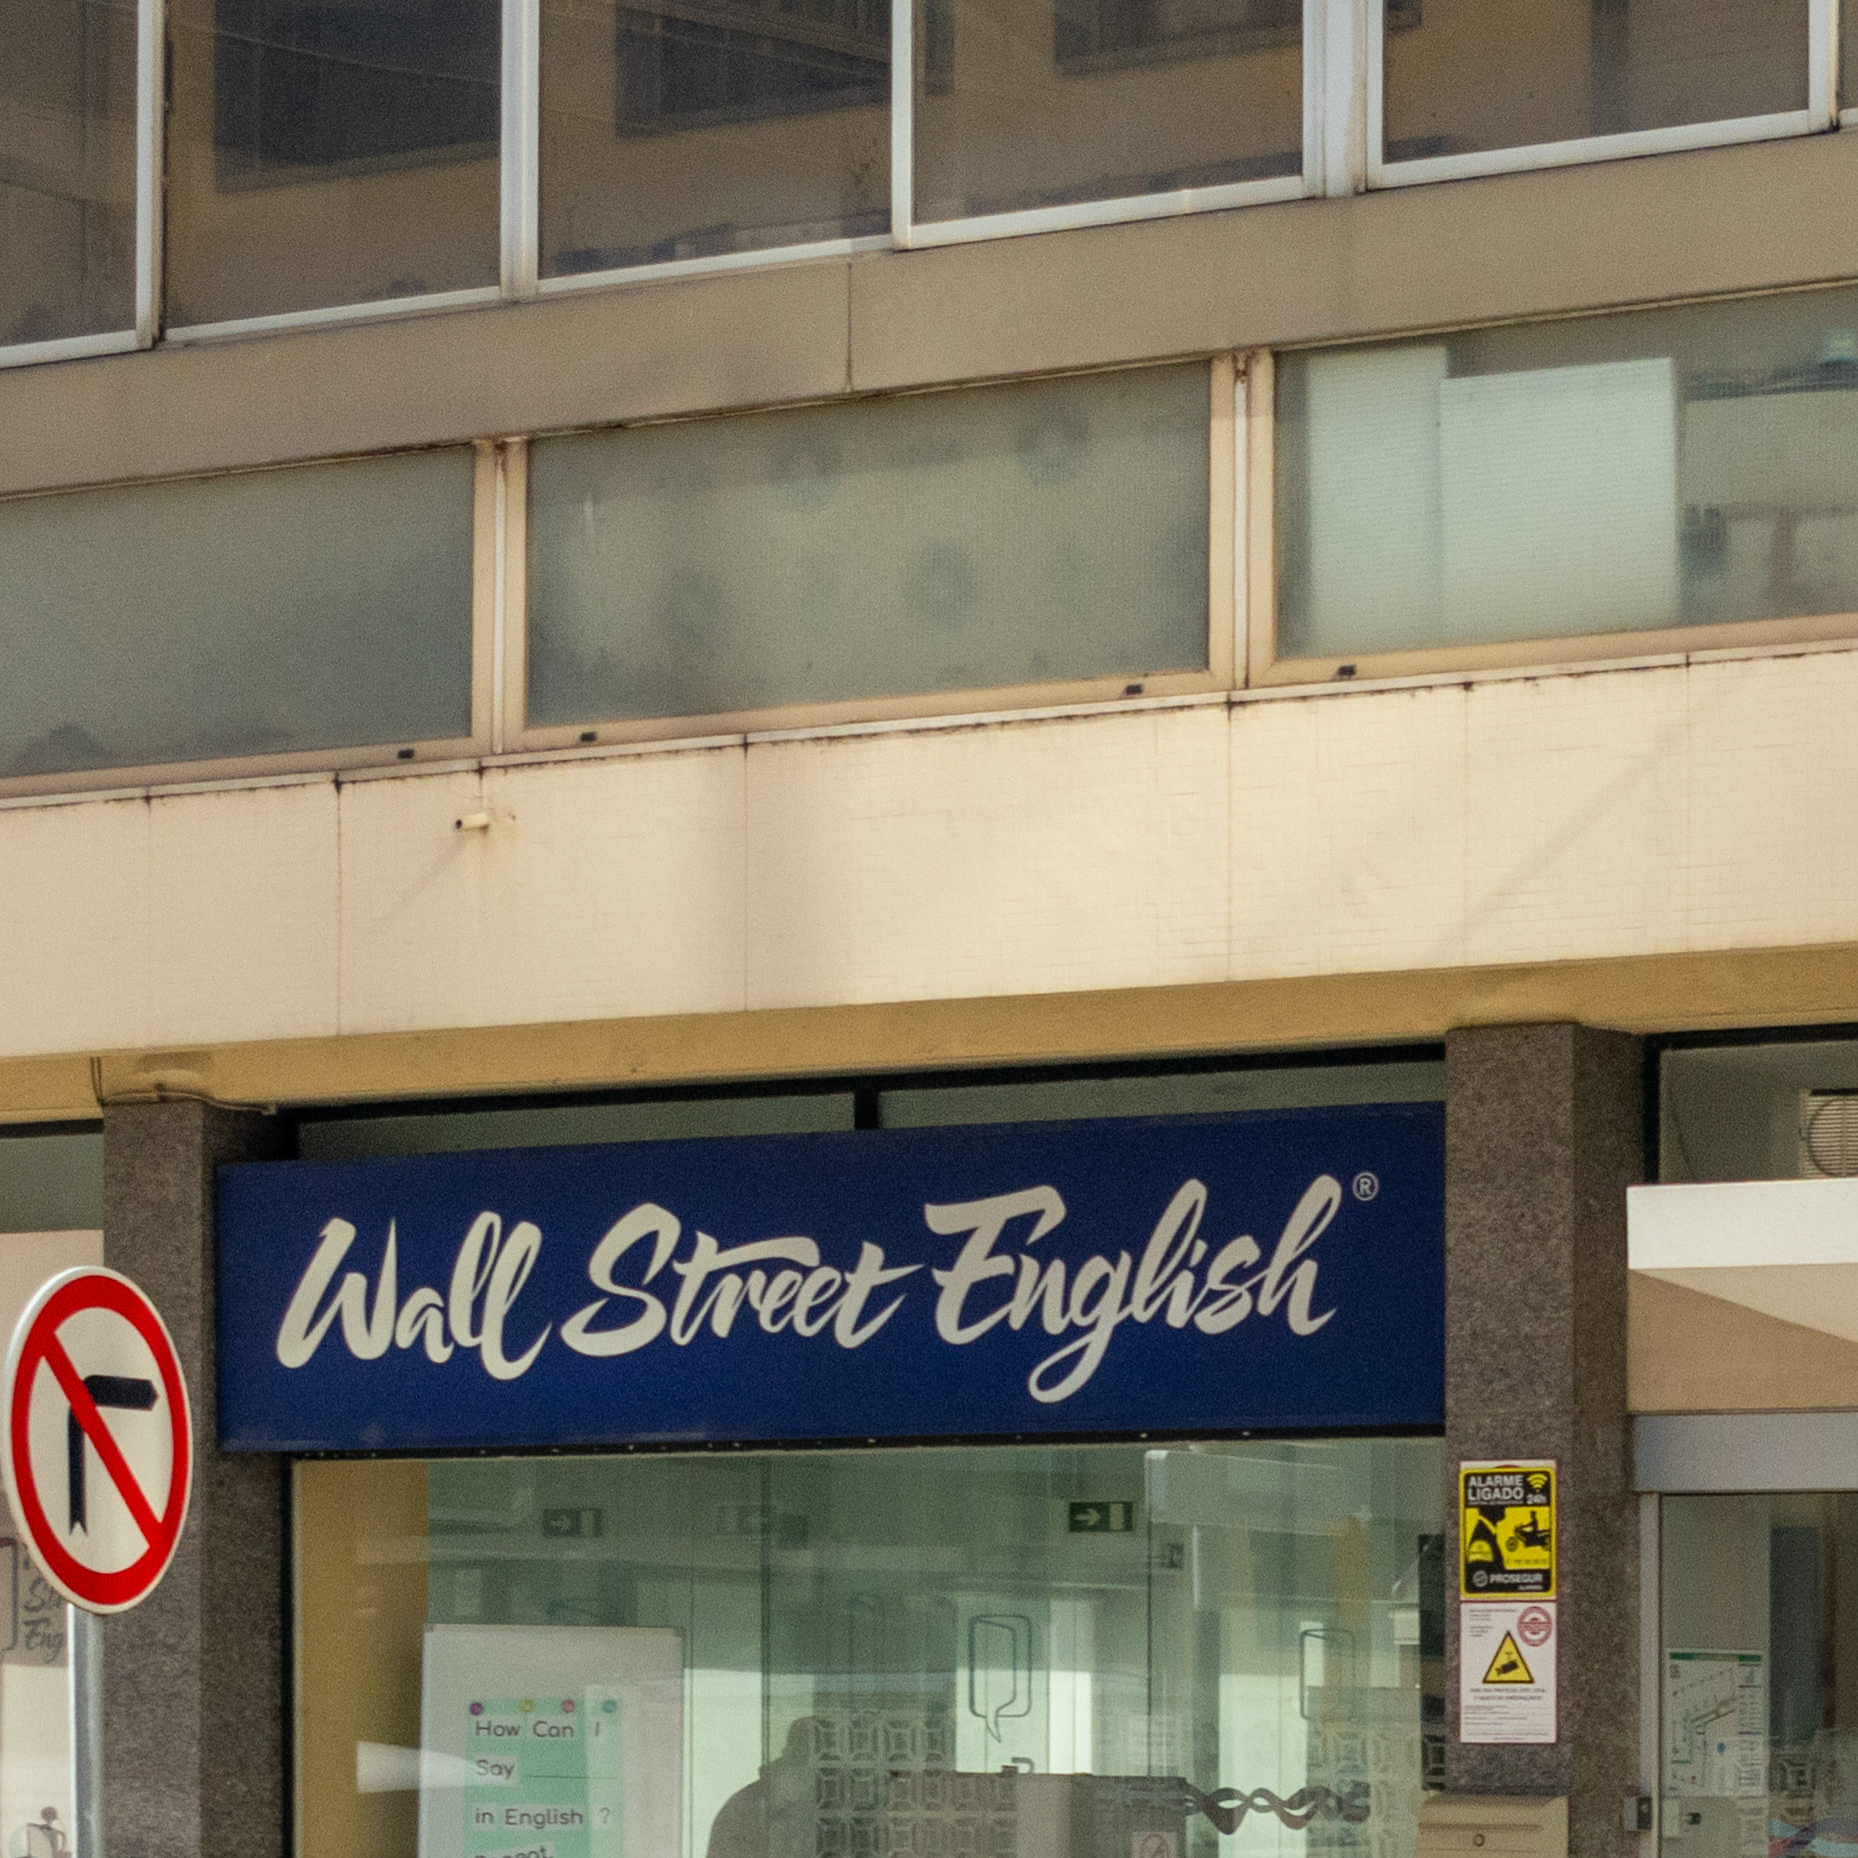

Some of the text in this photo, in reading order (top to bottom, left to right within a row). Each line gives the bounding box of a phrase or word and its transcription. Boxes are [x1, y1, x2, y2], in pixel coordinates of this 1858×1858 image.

[276, 1208, 552, 1382] Wall
[559, 1201, 926, 1357] Street
[1467, 1474, 1524, 1487] ALARME
[1467, 1487, 1524, 1501] LIGADO
[1489, 1573, 1543, 1584] PROSEGUR
[474, 1720, 601, 1738] How Can I
[476, 1759, 516, 1780] Say
[474, 1807, 494, 1824] in
[504, 1808, 584, 1830] English
